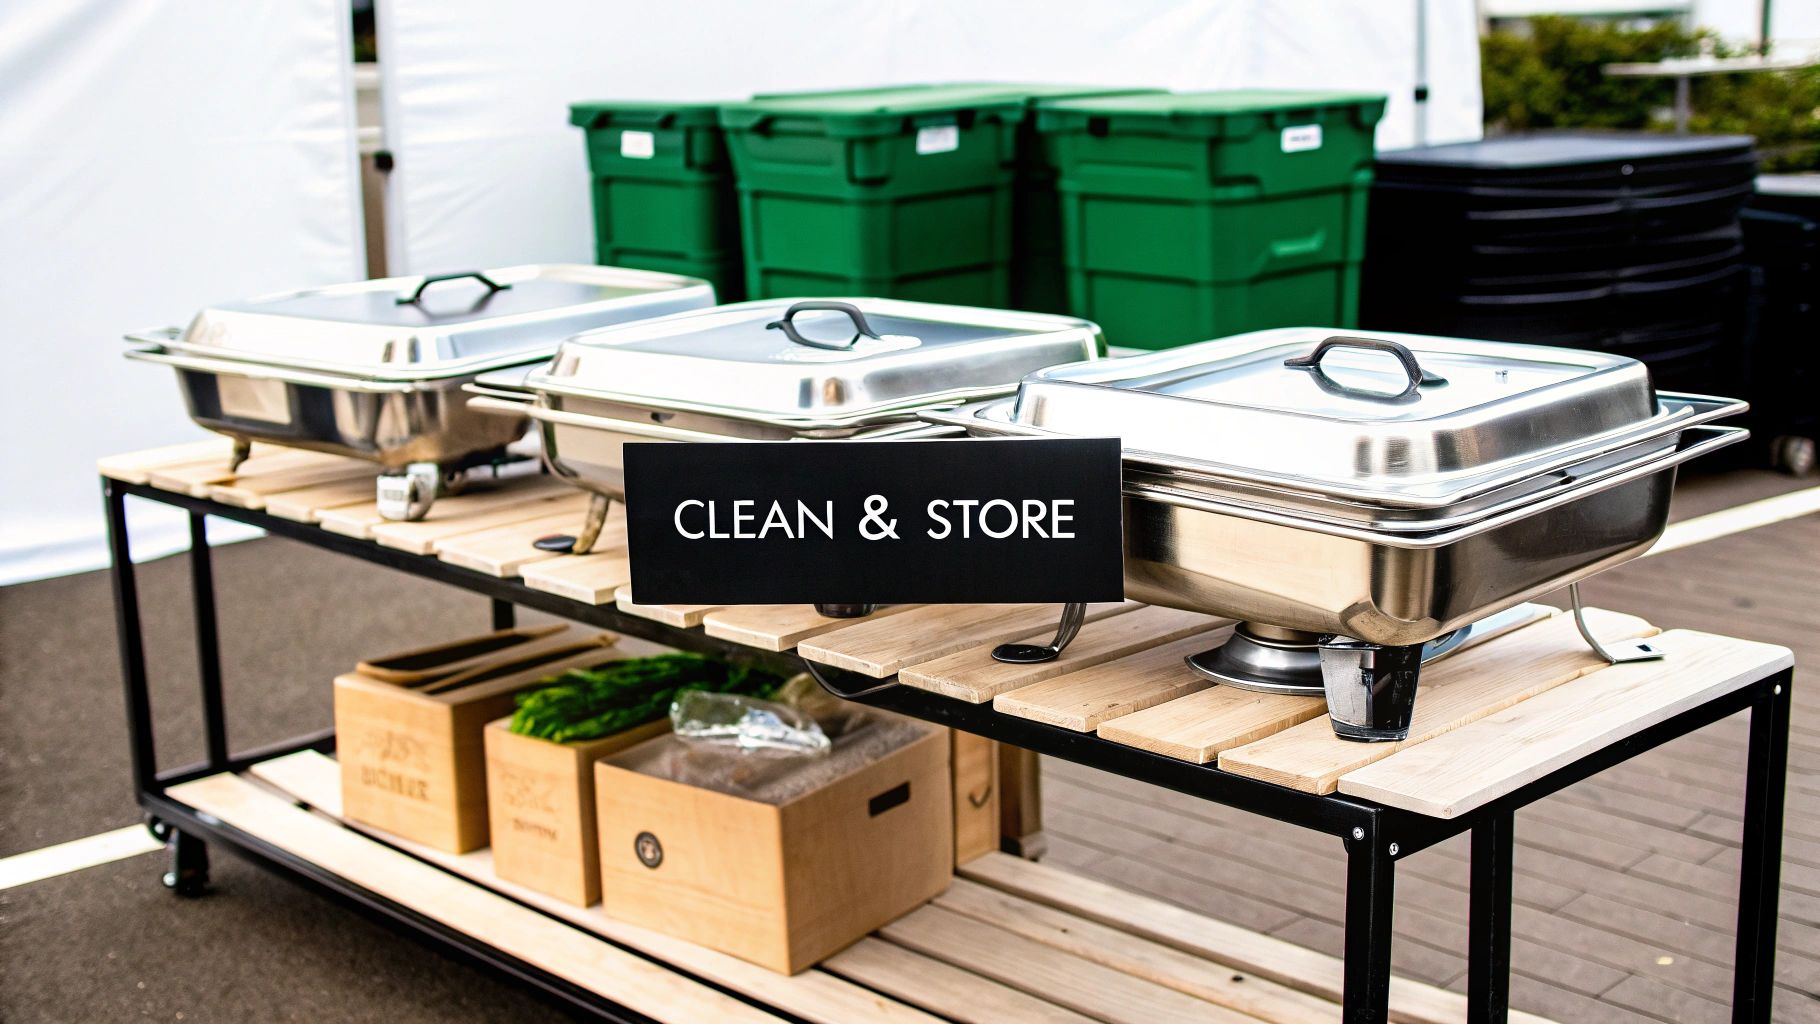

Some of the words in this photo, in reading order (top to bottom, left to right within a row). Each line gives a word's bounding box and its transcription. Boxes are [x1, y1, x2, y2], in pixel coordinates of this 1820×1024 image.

[674, 499, 834, 540] CLEAN
[858, 494, 901, 541] &
[926, 498, 1076, 540] STORE
